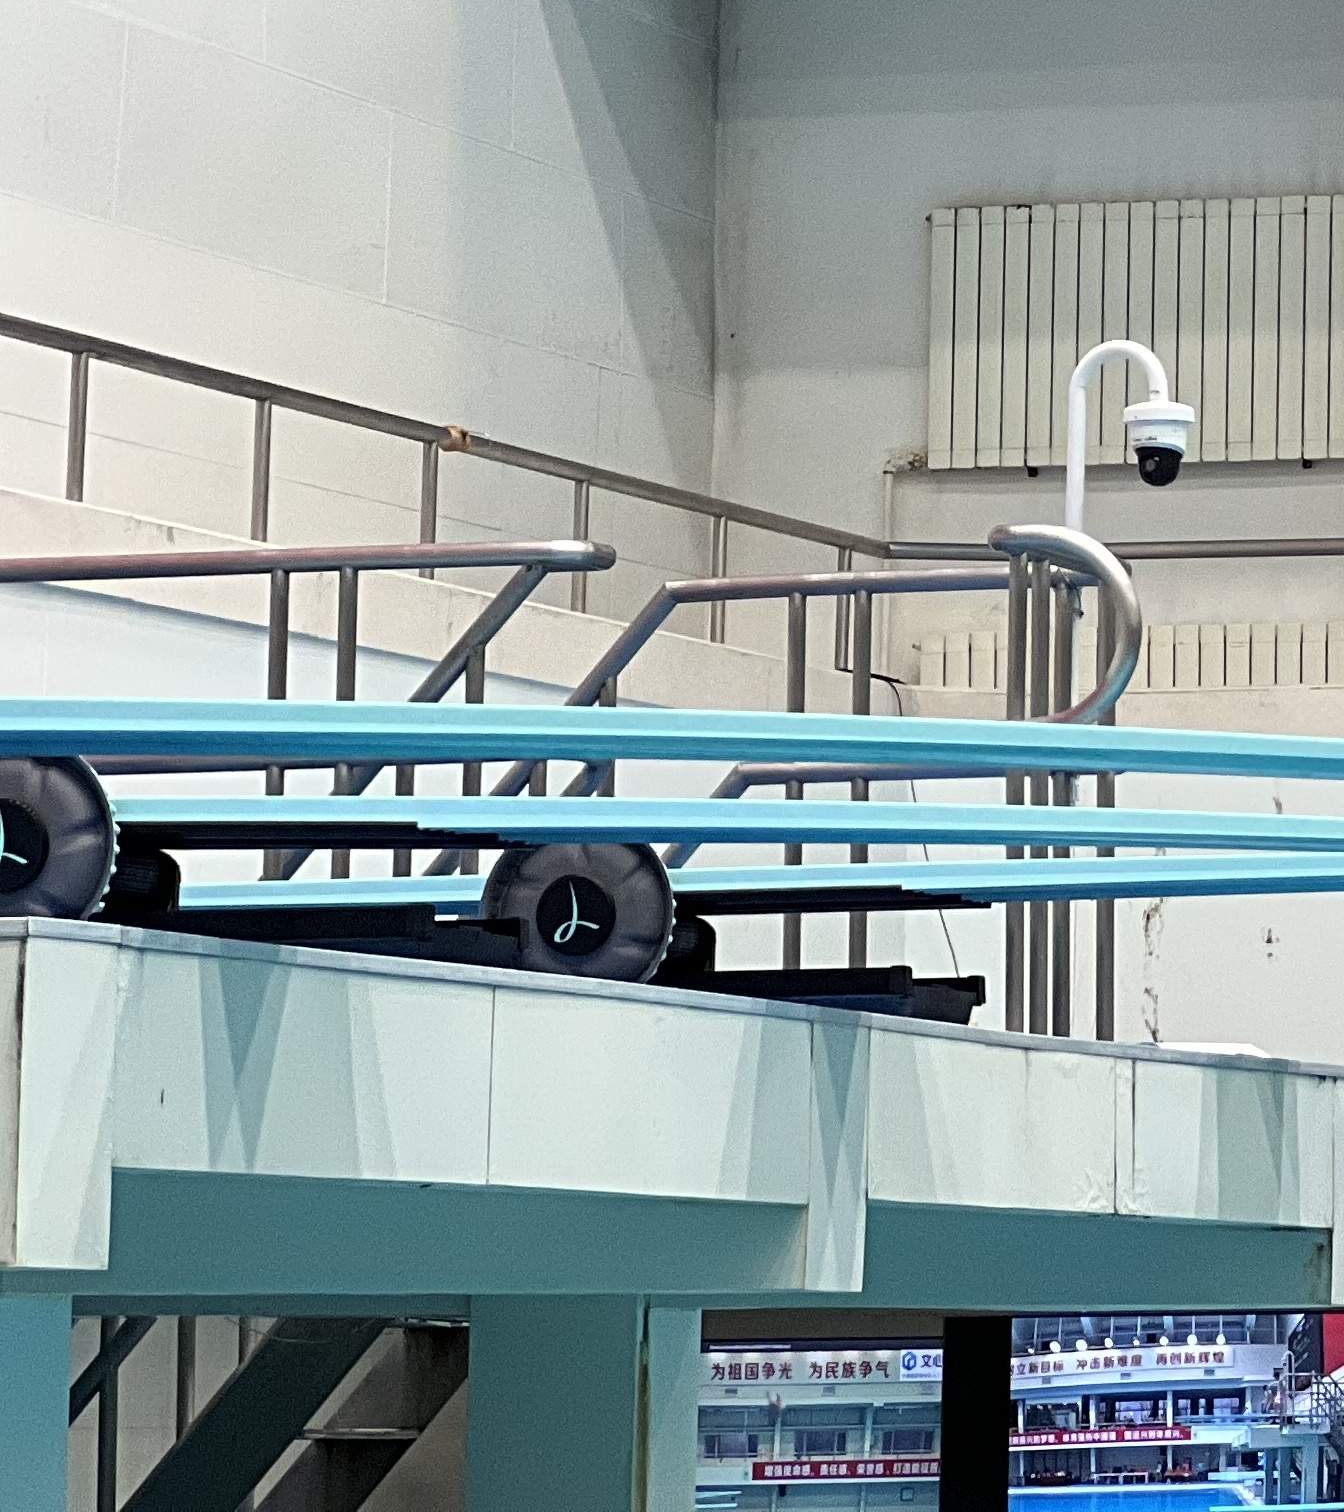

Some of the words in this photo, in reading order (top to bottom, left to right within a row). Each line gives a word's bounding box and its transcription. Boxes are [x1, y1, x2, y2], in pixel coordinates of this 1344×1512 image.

[711, 1362, 792, 1380] 为祖国争光
[809, 1361, 889, 1379] 为民族争气
